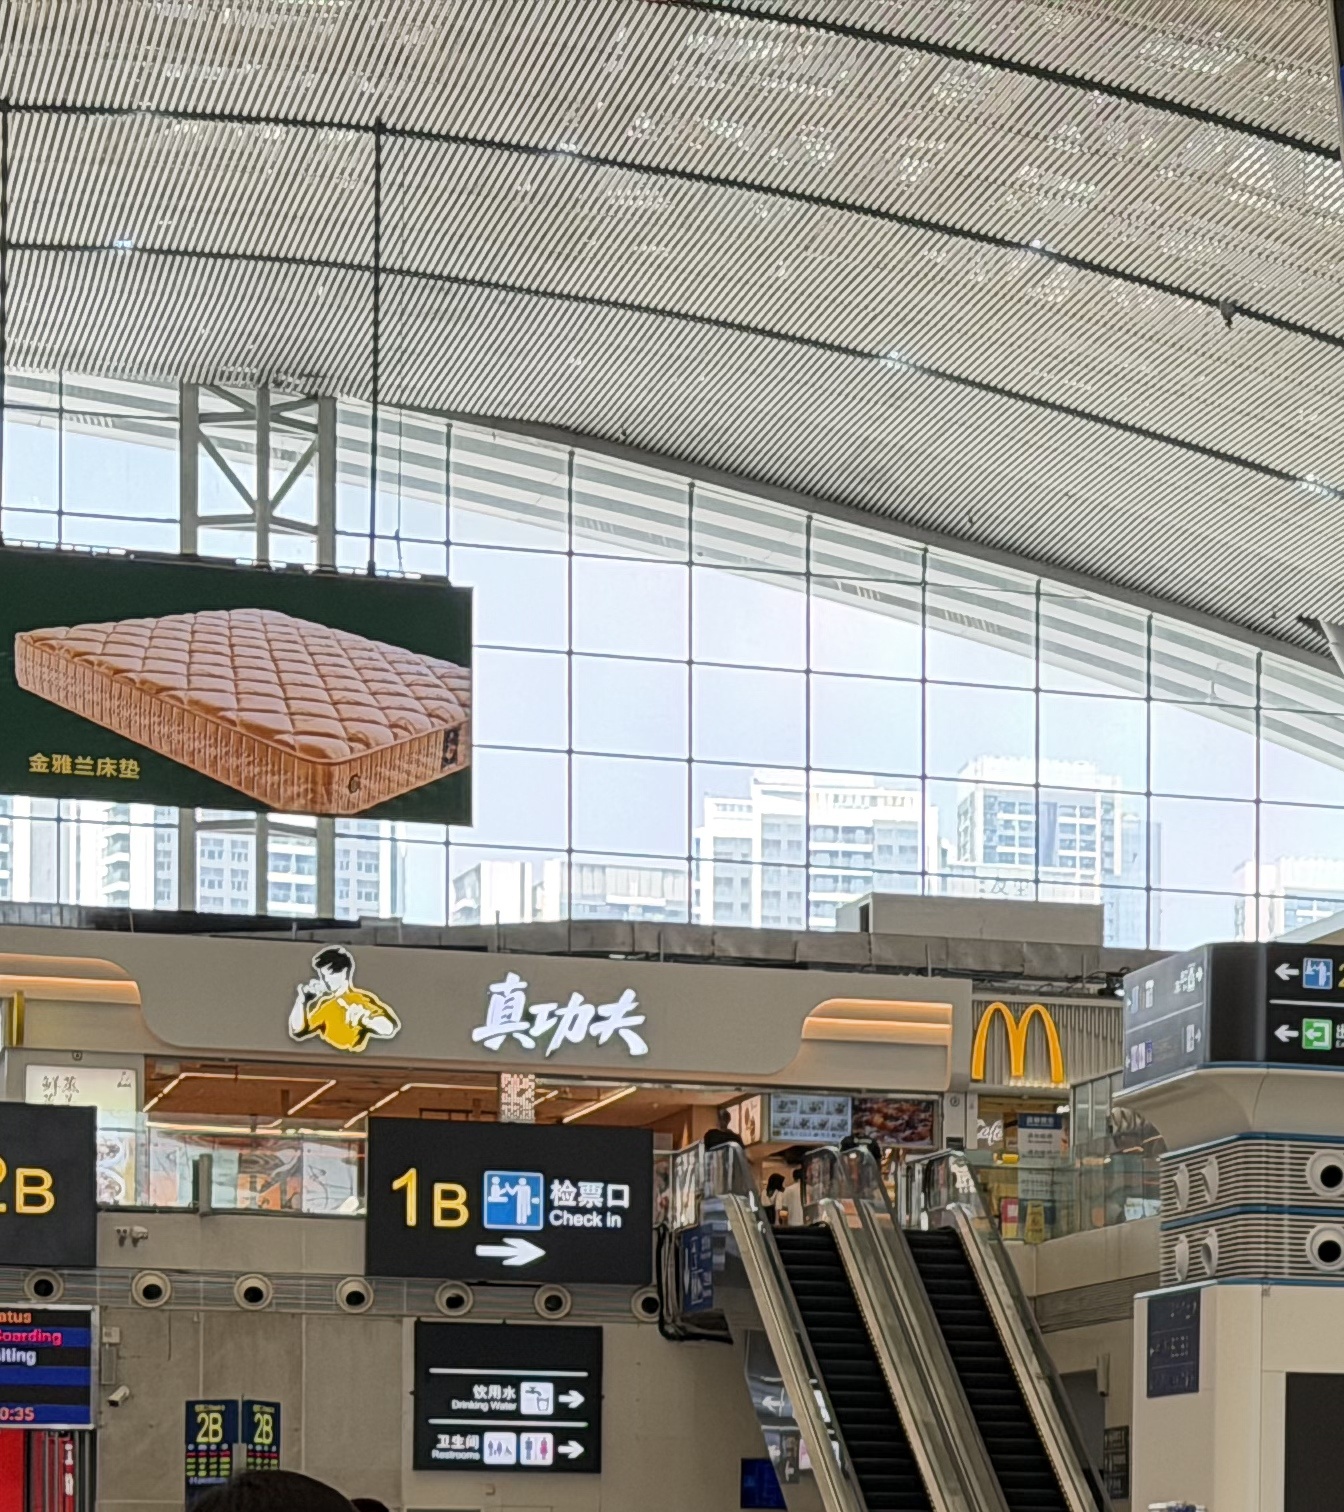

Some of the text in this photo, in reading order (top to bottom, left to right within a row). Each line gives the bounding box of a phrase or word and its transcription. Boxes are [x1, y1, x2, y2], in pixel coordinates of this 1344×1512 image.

[28, 752, 140, 780] 金雅兰床垫
[471, 972, 649, 1057] 真功夫
[392, 1168, 470, 1228] 1B
[550, 1178, 630, 1209] 检票口
[549, 1210, 603, 1228] Check
[0, 1329, 62, 1346] oarding
[472, 1384, 517, 1401] 饮用水
[196, 1412, 223, 1443] 2B
[253, 1412, 274, 1445] 2B
[435, 1433, 480, 1450] 卫生间
